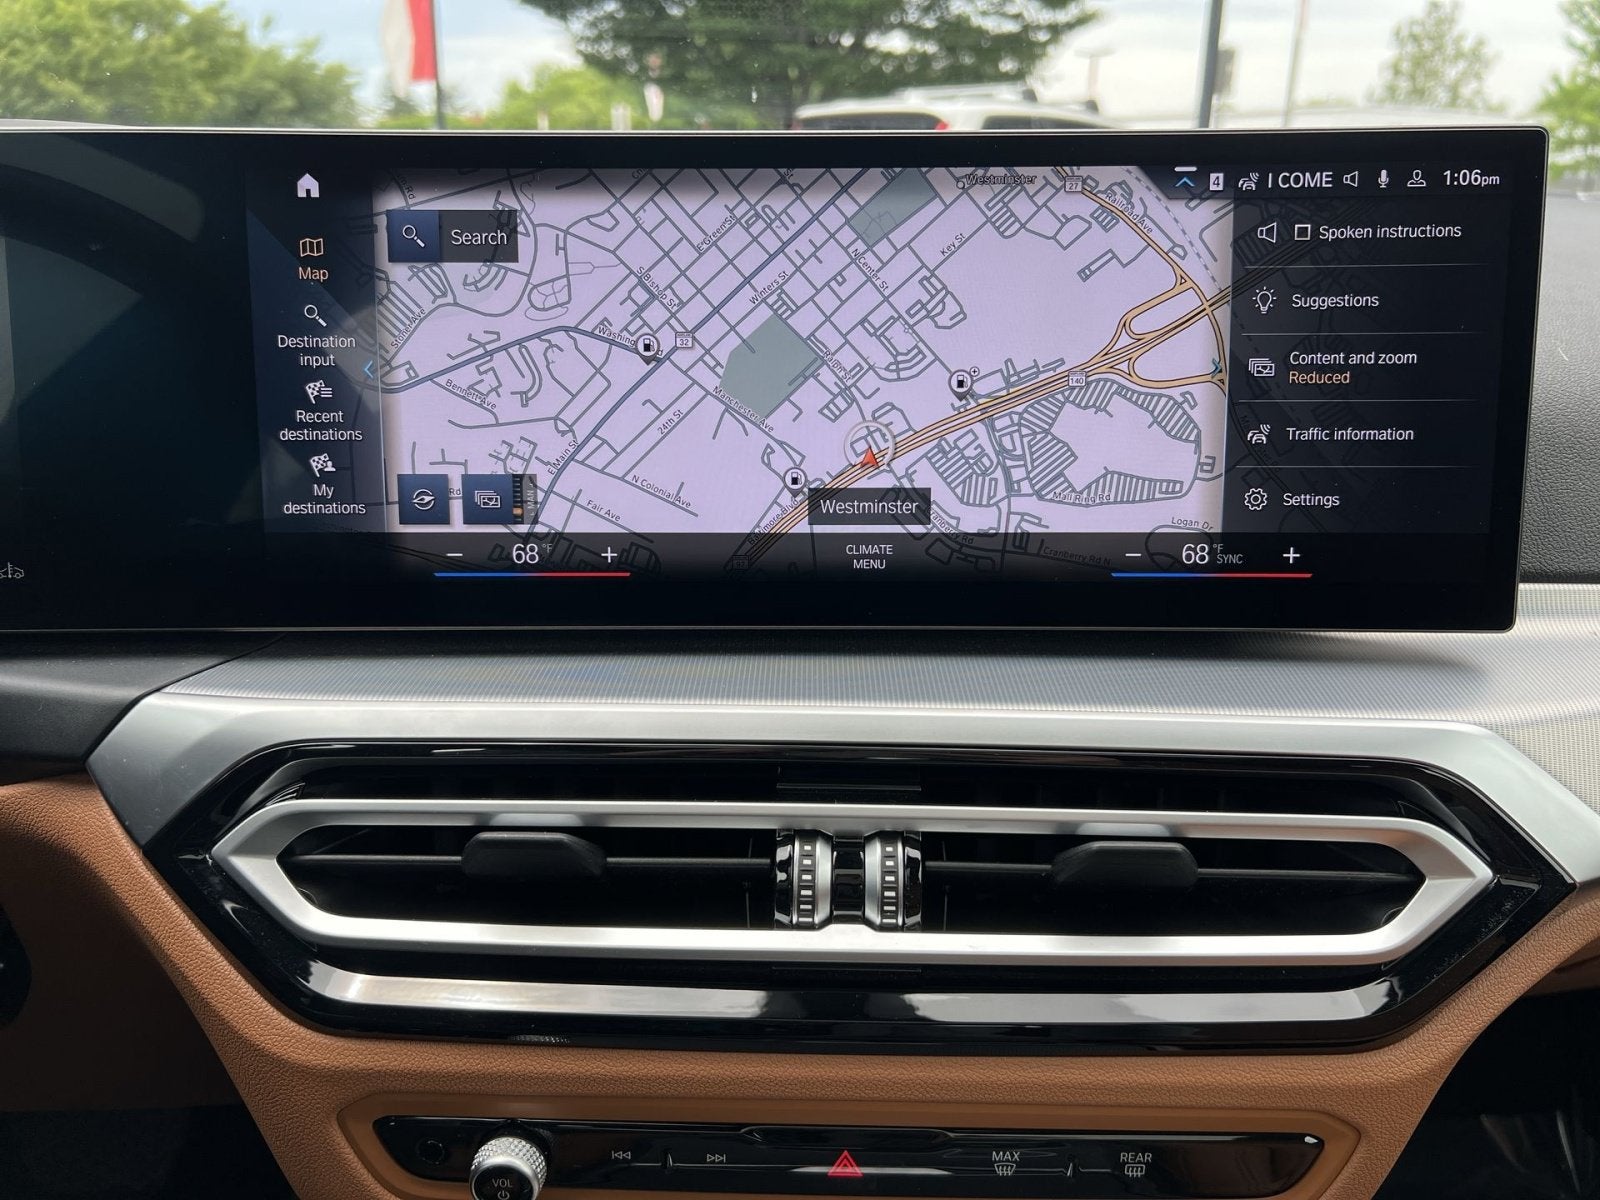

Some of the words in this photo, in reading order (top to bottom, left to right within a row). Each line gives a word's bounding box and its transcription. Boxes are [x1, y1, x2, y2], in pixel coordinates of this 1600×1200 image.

[965, 174, 1037, 186] Westminster
[1068, 182, 1079, 191] 27
[1212, 175, 1221, 188] 4
[1267, 172, 1272, 188] I
[1278, 172, 1333, 188] COME
[1443, 169, 1500, 187] 1:06pm
[1105, 191, 1140, 221] Railroad
[1138, 218, 1153, 235] Ave
[451, 229, 508, 246] Search
[703, 223, 727, 245] Green
[724, 214, 736, 226] St
[1319, 225, 1372, 242] Spoken
[1377, 223, 1462, 239] instructions
[940, 241, 957, 257] Key
[954, 232, 966, 244] St
[298, 266, 329, 283] Map
[851, 248, 861, 258] N
[857, 256, 880, 282] Center
[879, 280, 889, 292] St
[636, 266, 645, 275] S
[643, 272, 668, 301] Bishop
[666, 298, 677, 310] St
[749, 279, 780, 305] Winters
[777, 270, 789, 282] St
[1292, 294, 1379, 311] Suggestions
[390, 324, 412, 349] Stoner
[411, 308, 426, 324] Ave
[598, 325, 637, 348] Washing
[277, 335, 356, 348] Destination
[679, 338, 690, 347] 32
[300, 352, 335, 369] input
[823, 349, 845, 374] Ralph
[841, 371, 852, 383] St
[1289, 351, 1344, 366] Content
[1348, 351, 1375, 365] and
[1377, 352, 1418, 365] zoom
[1069, 377, 1084, 385] 140
[1289, 371, 1350, 385] Reduced
[445, 378, 480, 402] Bennett
[480, 396, 497, 411] Ave
[296, 409, 344, 423] Recent
[712, 385, 759, 422] Manchester
[759, 417, 775, 434] Ave
[657, 417, 676, 436] 24th
[672, 408, 684, 421] St
[279, 427, 363, 442] destinations
[1286, 426, 1330, 441] Traffic
[1334, 426, 1415, 441] information
[547, 467, 556, 475] E
[552, 448, 571, 469] Main
[568, 439, 579, 450] St
[313, 484, 334, 500] My
[449, 487, 461, 496] Rd
[527, 490, 535, 509] MAN
[631, 474, 640, 484] N
[640, 478, 676, 501] Colonial
[674, 495, 692, 509] Ave
[1052, 490, 1073, 501] Mall
[1074, 493, 1096, 504] Ring
[1098, 491, 1111, 501] Rd
[283, 501, 366, 515] destinations
[780, 496, 800, 515] Blvd
[820, 498, 919, 514] Westminster
[1283, 492, 1340, 509] Settings
[586, 499, 604, 513] Fair
[604, 508, 622, 522] Ave
[930, 510, 961, 541] ranberry
[961, 534, 975, 545] Rd
[1171, 516, 1199, 528] Logan
[1201, 520, 1215, 532] Dr
[512, 543, 539, 564] 68
[846, 544, 893, 556] CLIMATE
[1043, 546, 1088, 562] Cranberry
[1089, 555, 1102, 565] Rd
[1102, 558, 1112, 567] N
[1182, 543, 1209, 564] 68
[1216, 553, 1243, 564] SYNC
[853, 559, 886, 569] MENU
[992, 1151, 1020, 1162] MAX
[1120, 1152, 1152, 1163] REAR
[492, 1178, 513, 1189] VOL
